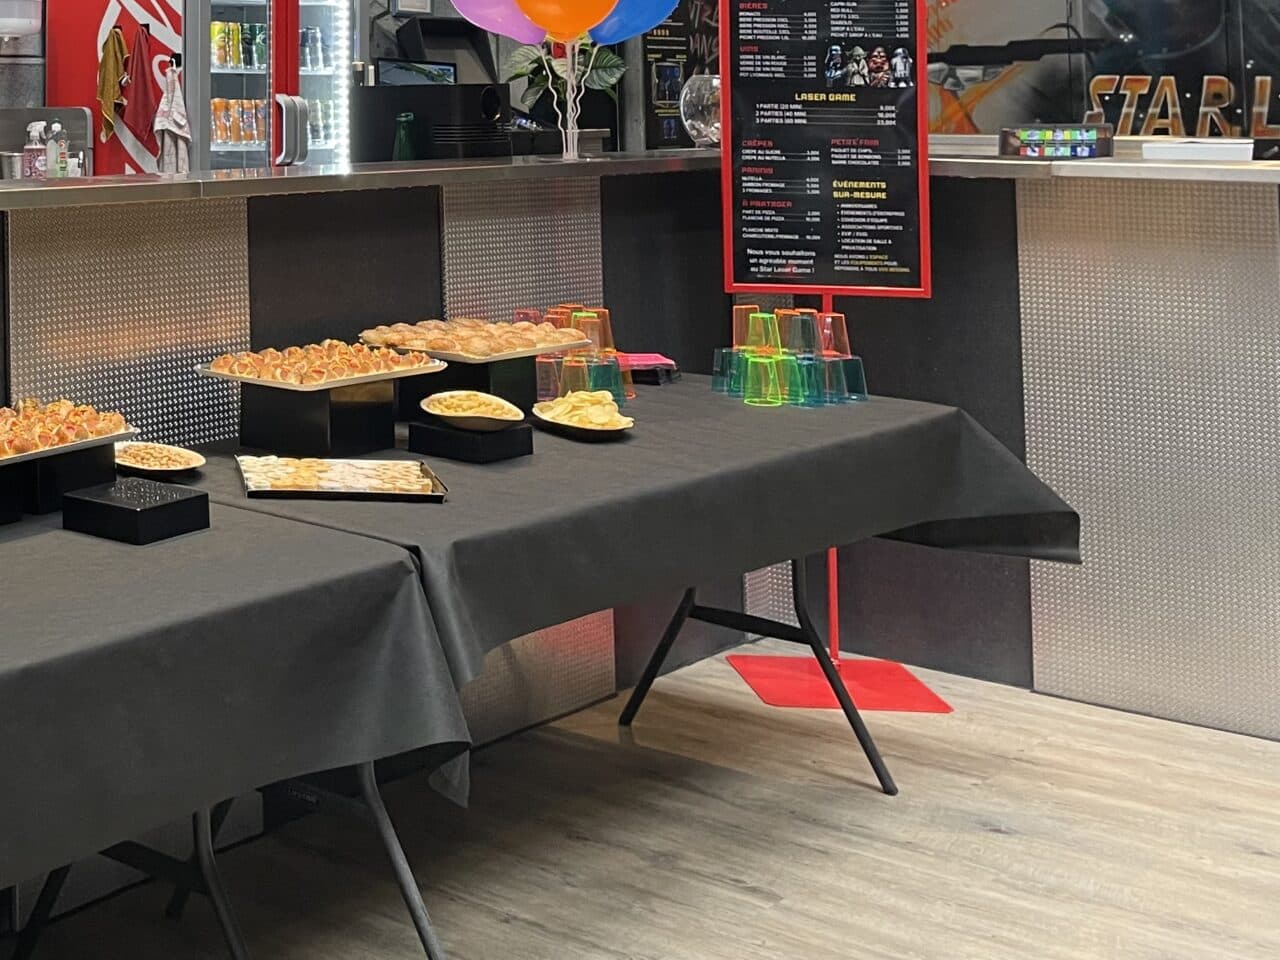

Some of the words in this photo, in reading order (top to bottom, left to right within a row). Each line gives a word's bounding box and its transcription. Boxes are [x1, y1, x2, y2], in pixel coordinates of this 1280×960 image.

[795, 93, 826, 101] LASER
[828, 93, 856, 102] GAME
[1082, 75, 1241, 138] STAR
[833, 191, 887, 199] SUR-MESURE
